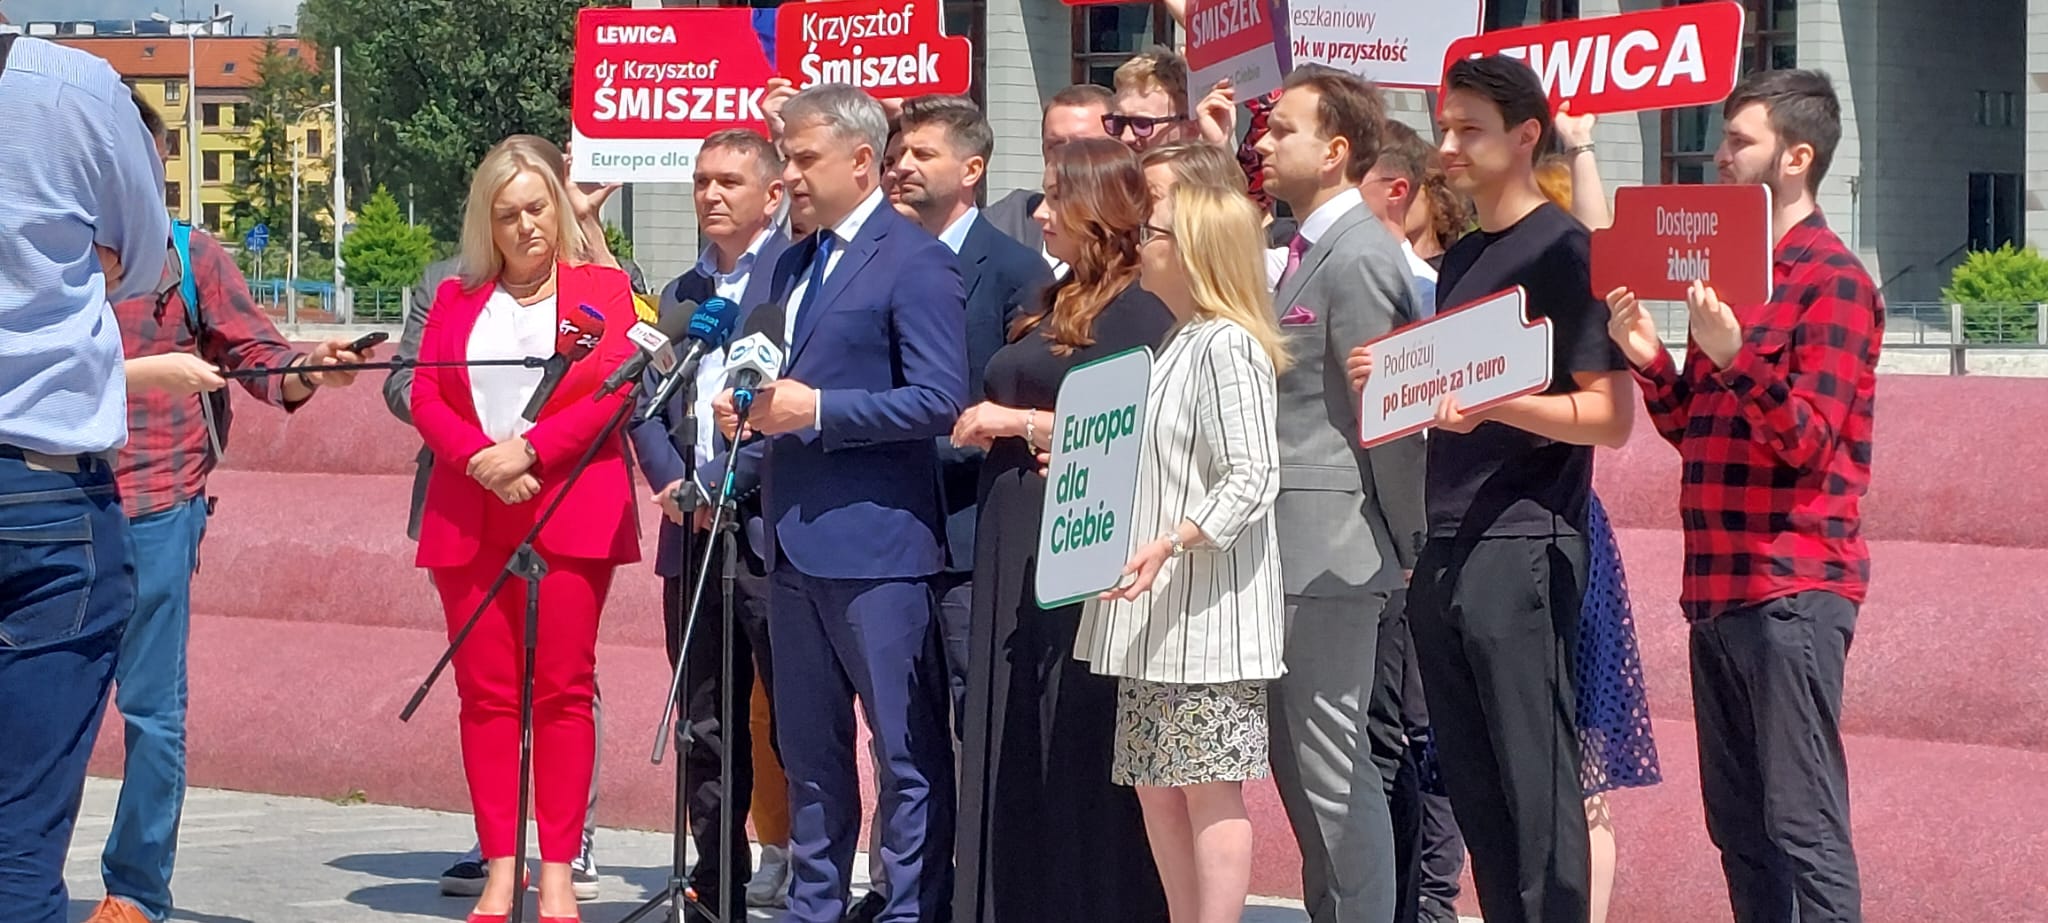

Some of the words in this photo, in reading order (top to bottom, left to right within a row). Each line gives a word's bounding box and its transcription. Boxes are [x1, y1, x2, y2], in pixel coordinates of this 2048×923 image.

[597, 25, 677, 44] LEWICA
[802, 4, 915, 47] Krzysztof
[1192, 0, 1262, 49] ŚMISZEK
[595, 58, 618, 79] dr
[623, 59, 719, 83] Krzysztof
[800, 42, 940, 90] Śmiszek
[1312, 41, 1325, 58] w
[1327, 37, 1408, 65] przyszłość
[1469, 24, 1706, 99] WICA
[592, 77, 766, 121] ŚMISZEK
[591, 152, 655, 171] Europa
[660, 152, 689, 166] dla
[1656, 206, 1718, 244] Dostępne
[1667, 247, 1710, 282] żłobki
[1384, 336, 1434, 378] Podróżuj
[1383, 392, 1399, 421] po
[1401, 368, 1448, 408] Europie
[1450, 369, 1464, 391] za
[1467, 361, 1473, 385] 1
[1476, 355, 1506, 382] euro
[1062, 404, 1137, 455] Europa
[1056, 461, 1089, 504] dla
[1050, 500, 1115, 555] Ciebie
